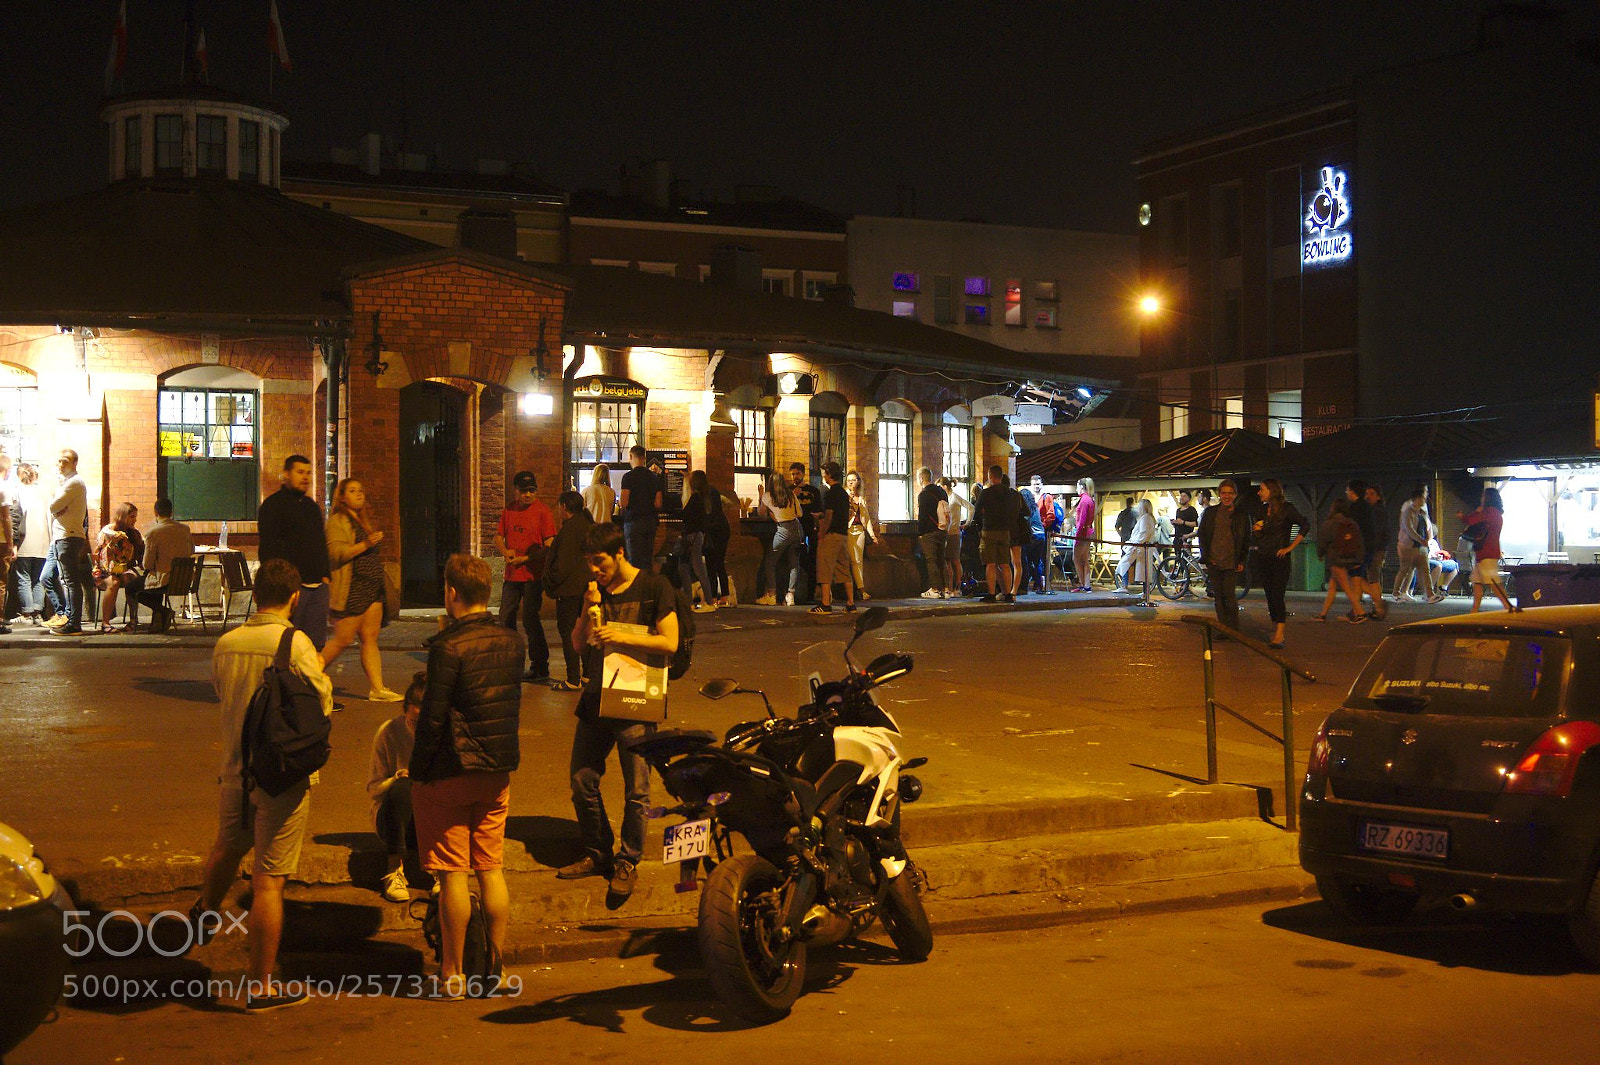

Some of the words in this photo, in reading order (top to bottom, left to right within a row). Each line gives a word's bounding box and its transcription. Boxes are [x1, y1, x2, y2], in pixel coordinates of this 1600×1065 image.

[1303, 236, 1347, 260] BOWLING
[1318, 404, 1337, 416] KLUB
[1390, 680, 1421, 688] SUZUKI
[674, 825, 702, 842] KRA
[1366, 826, 1390, 847] RZ
[1394, 829, 1445, 854] 69336
[666, 840, 705, 860] F17U
